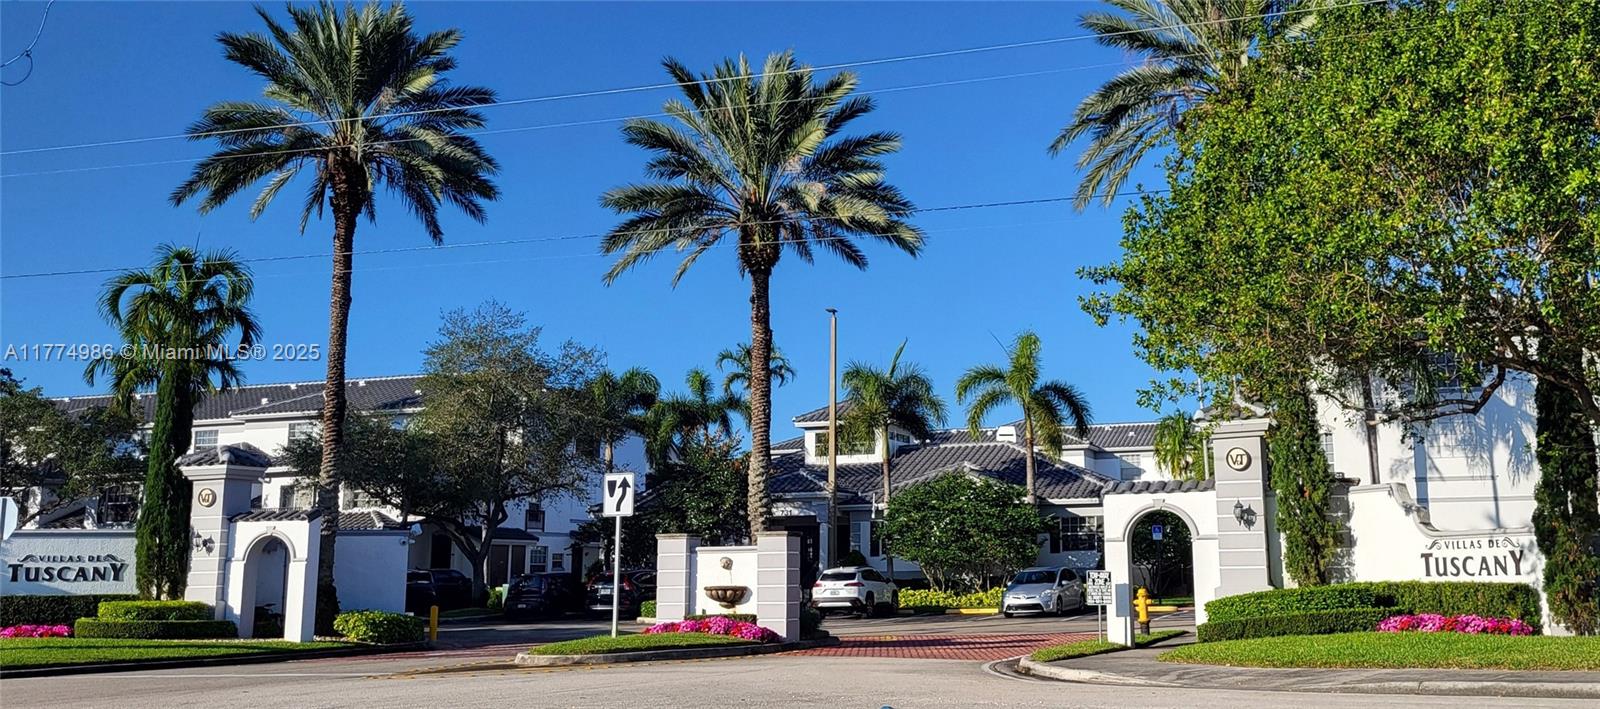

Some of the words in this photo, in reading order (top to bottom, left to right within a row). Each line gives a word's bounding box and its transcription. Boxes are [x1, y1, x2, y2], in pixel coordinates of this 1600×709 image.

[1444, 539, 1482, 550] VILLAS
[1488, 539, 1501, 549] DE
[38, 554, 81, 563] VILLAS
[88, 554, 104, 563] DE
[1420, 549, 1524, 577] TUSCANY
[8, 562, 128, 582] TUSCANY
